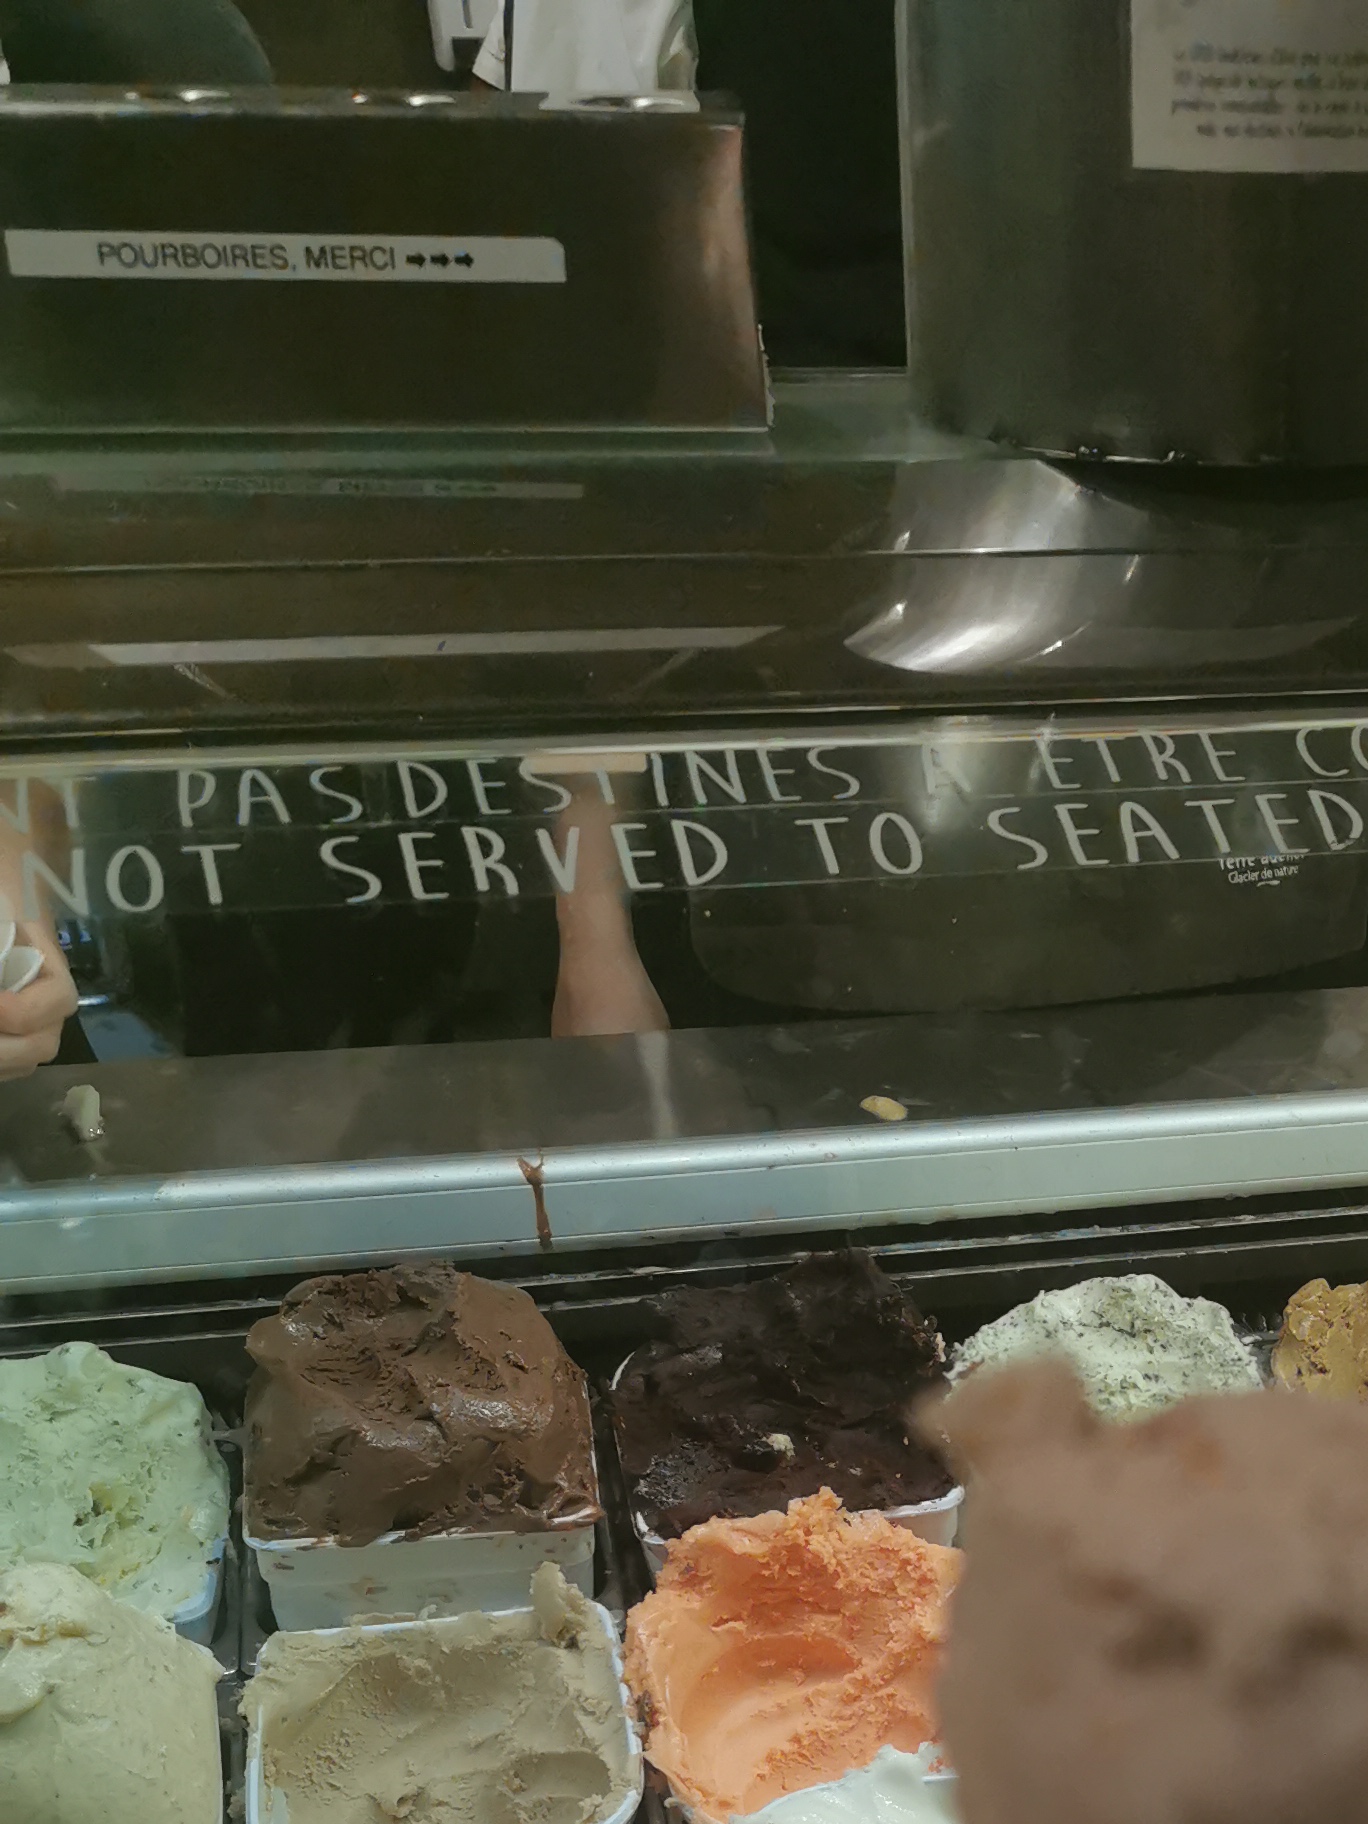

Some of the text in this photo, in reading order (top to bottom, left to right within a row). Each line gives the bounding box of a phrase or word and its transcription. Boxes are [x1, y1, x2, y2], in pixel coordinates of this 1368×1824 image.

[98, 241, 396, 273] POURBOIRES, MERCI
[21, 842, 242, 918] NOT
[318, 818, 730, 904] SERVED
[793, 811, 925, 877] TO
[986, 788, 1365, 871] SEATED
